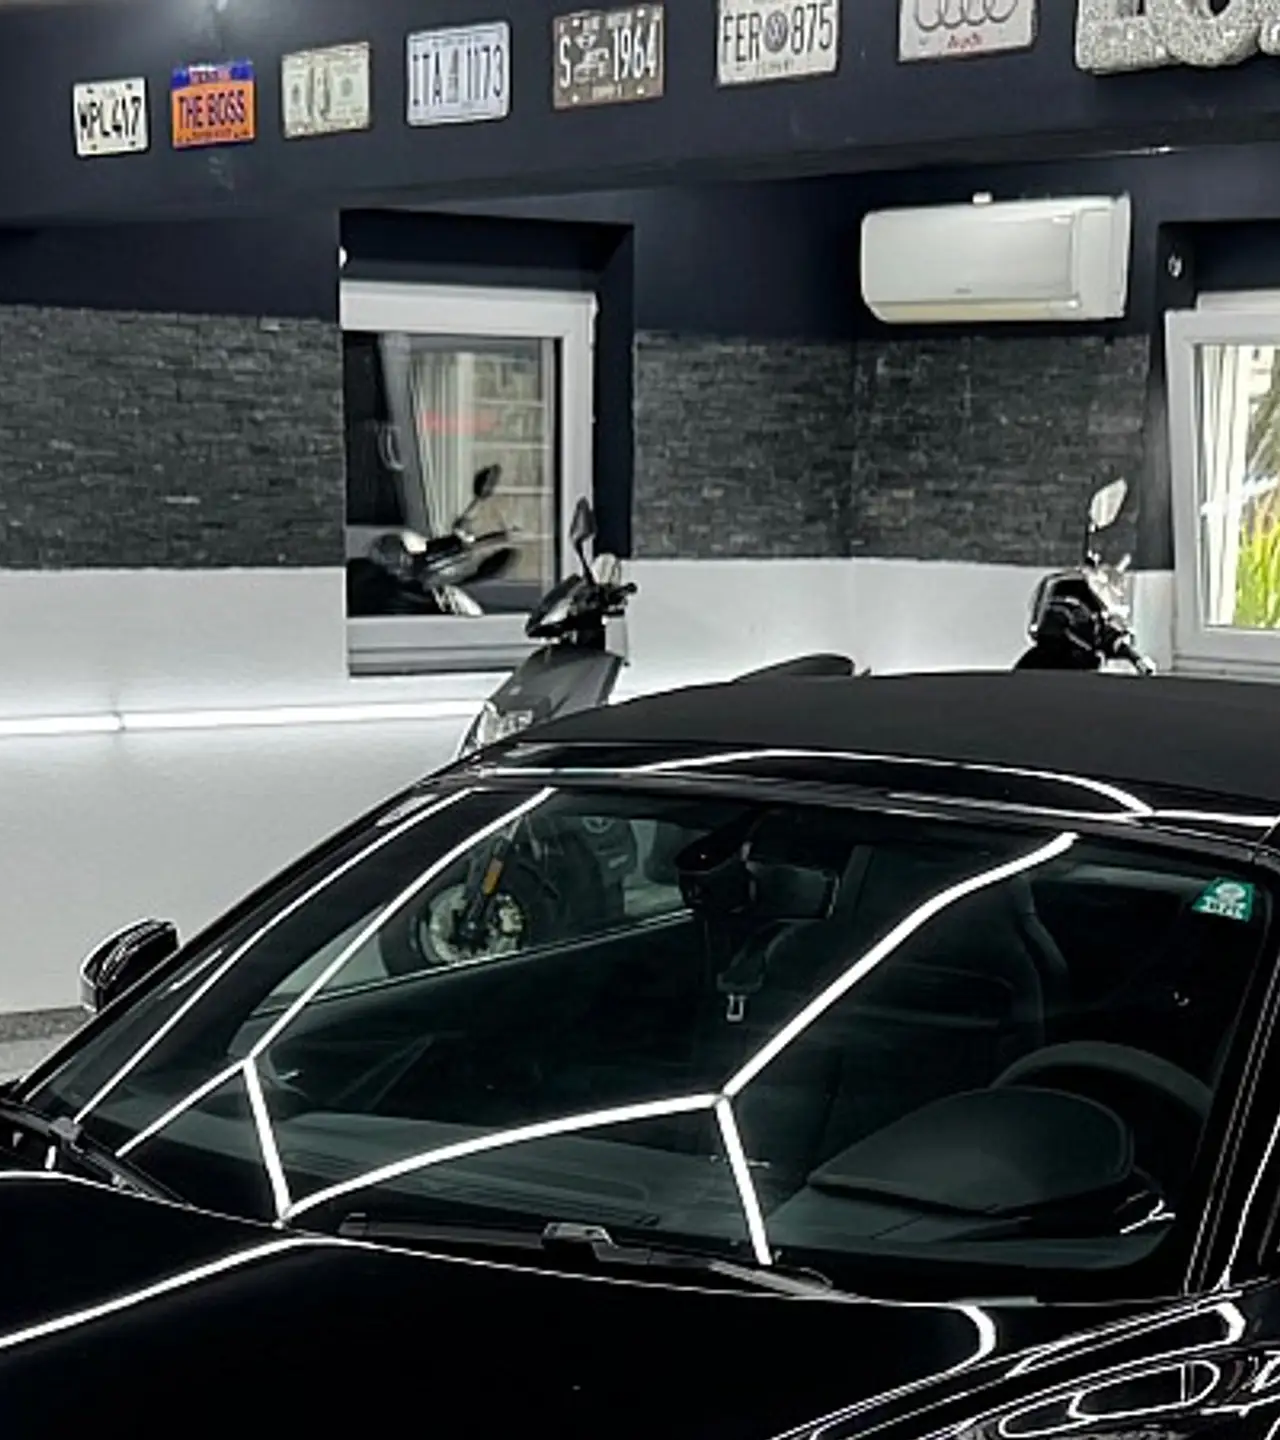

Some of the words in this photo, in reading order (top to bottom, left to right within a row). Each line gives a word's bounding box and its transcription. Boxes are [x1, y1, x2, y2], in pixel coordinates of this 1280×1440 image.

[612, 22, 658, 82] 1964
[723, 11, 762, 64] FER
[790, 3, 833, 56] 875
[178, 96, 203, 129] THE
[207, 89, 245, 126] BOSS
